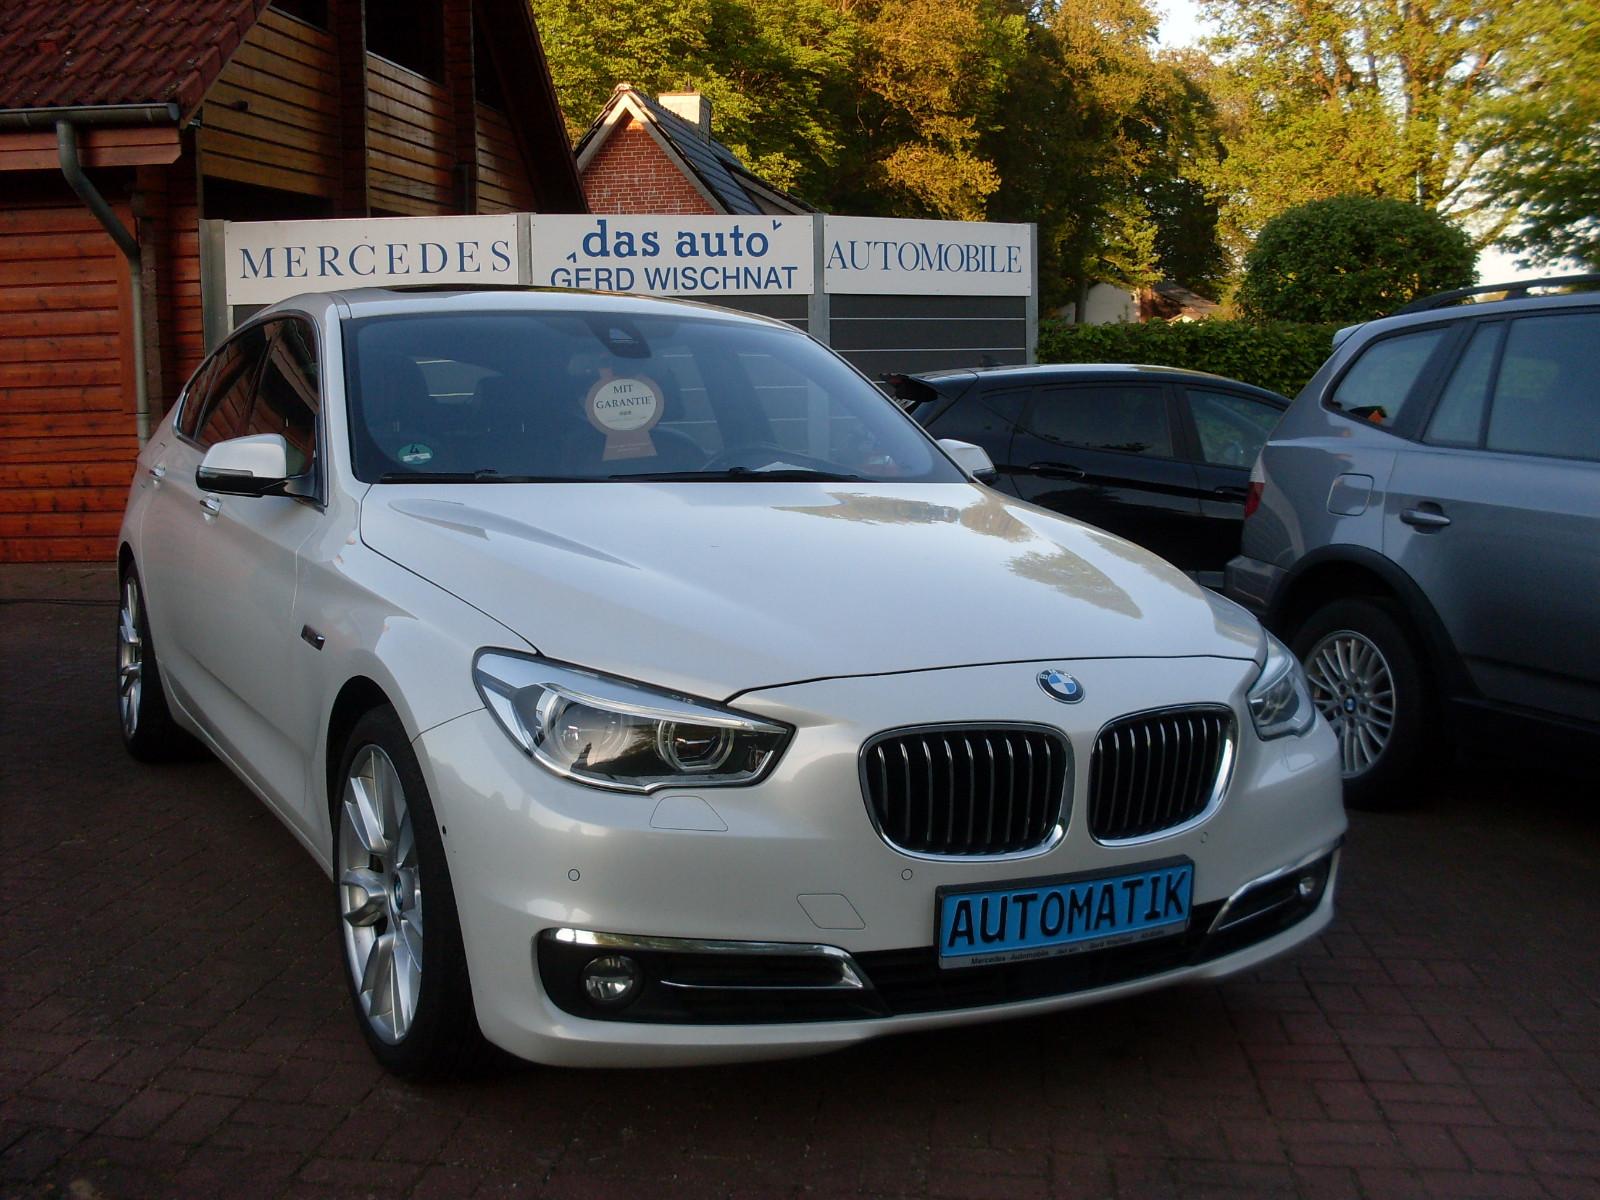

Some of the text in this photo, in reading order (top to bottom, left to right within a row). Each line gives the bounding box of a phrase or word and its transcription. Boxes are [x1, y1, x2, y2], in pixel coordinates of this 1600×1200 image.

[239, 240, 512, 280] MERCEDES
[826, 239, 1022, 274] AUTOMOBILE
[550, 265, 798, 291] GERD WISCHNAT
[595, 395, 652, 410] GARANTIE
[613, 384, 633, 394] MIT
[947, 870, 1188, 948] AUTOMATIK
